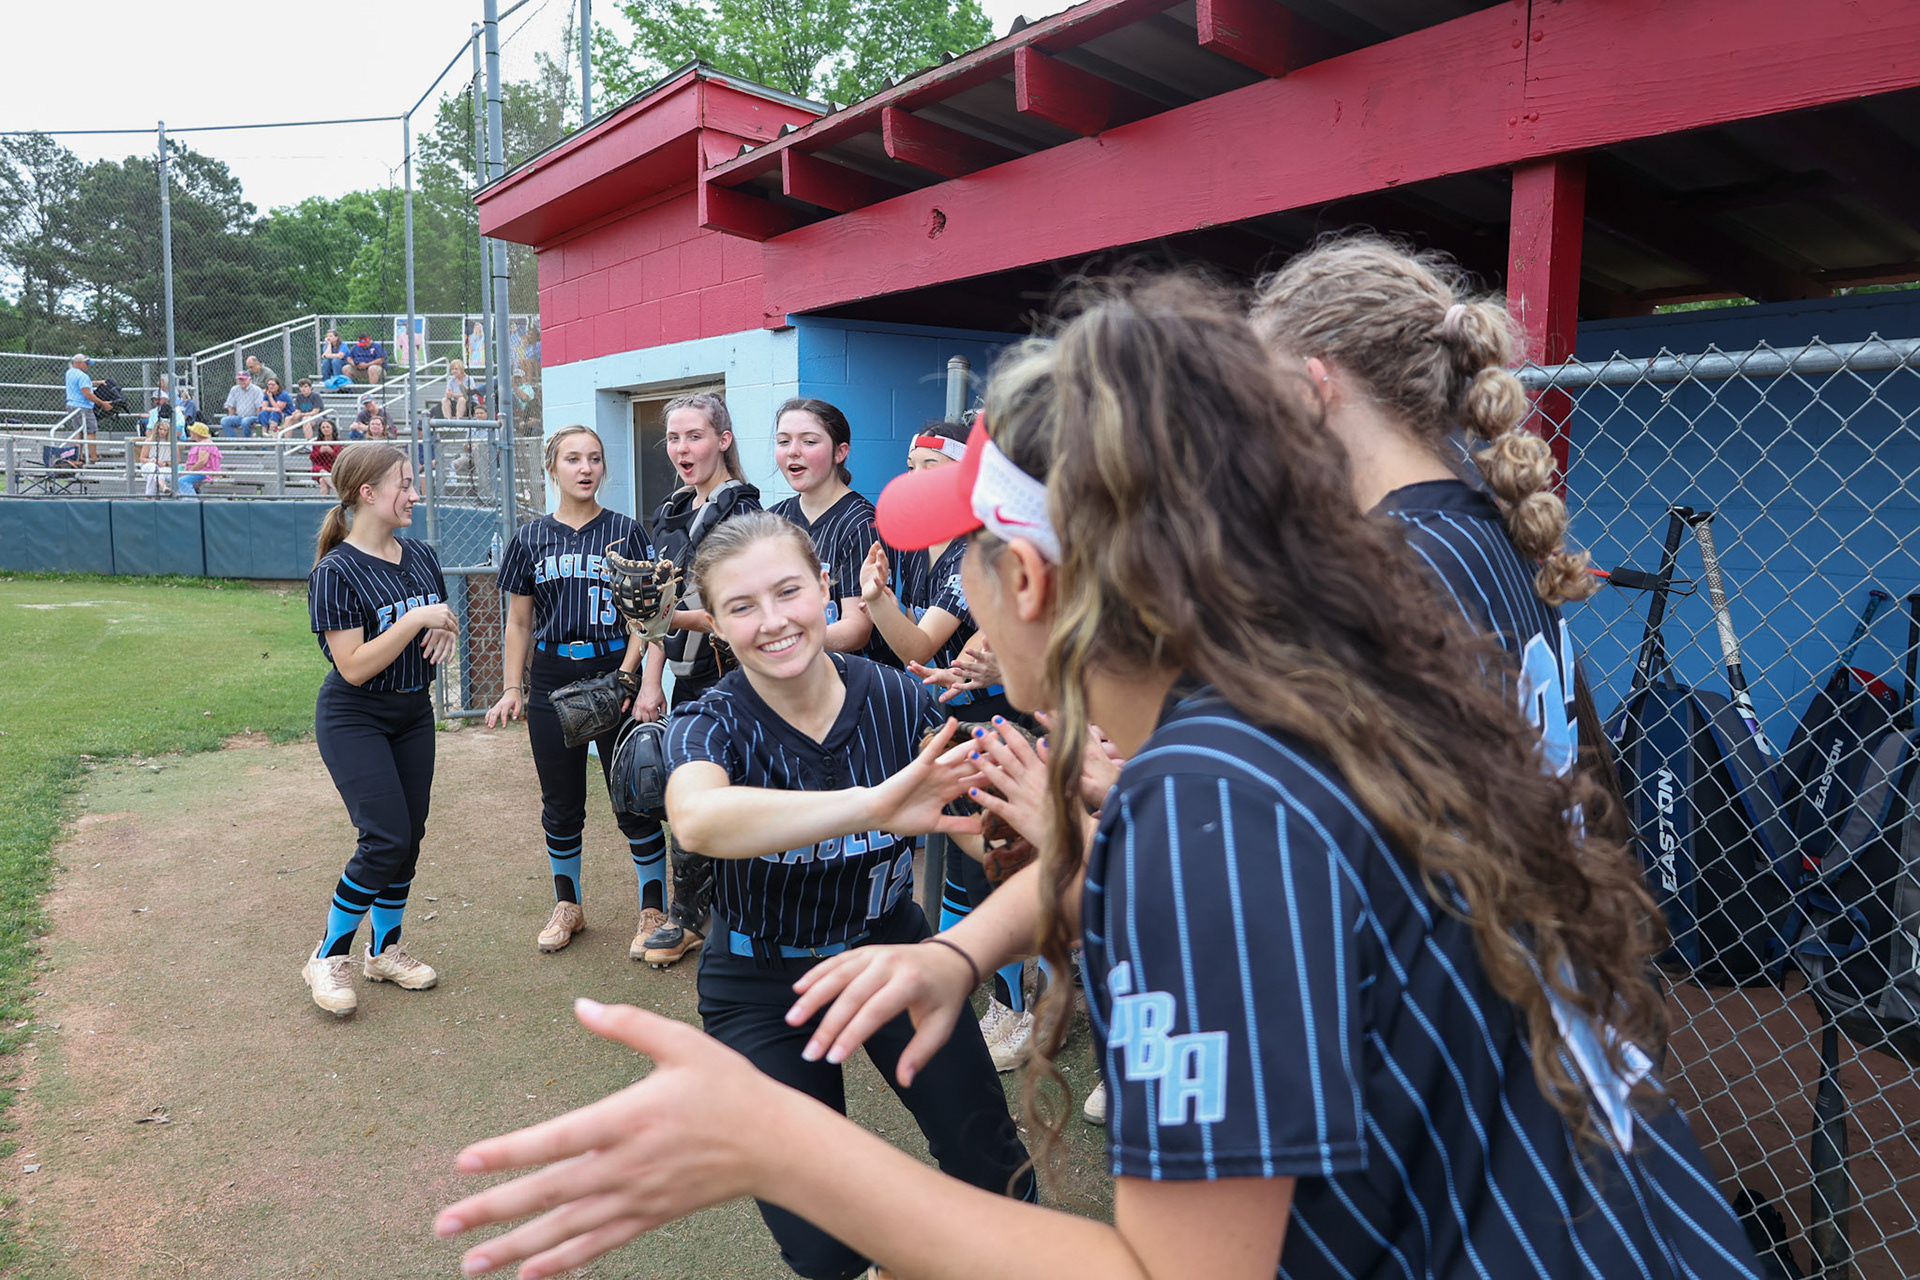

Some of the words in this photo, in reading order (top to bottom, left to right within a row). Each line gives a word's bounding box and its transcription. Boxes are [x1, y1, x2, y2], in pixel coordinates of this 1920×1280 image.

[588, 586, 617, 625] 13
[1656, 769, 1679, 892] EASTON
[866, 846, 913, 920] 12
